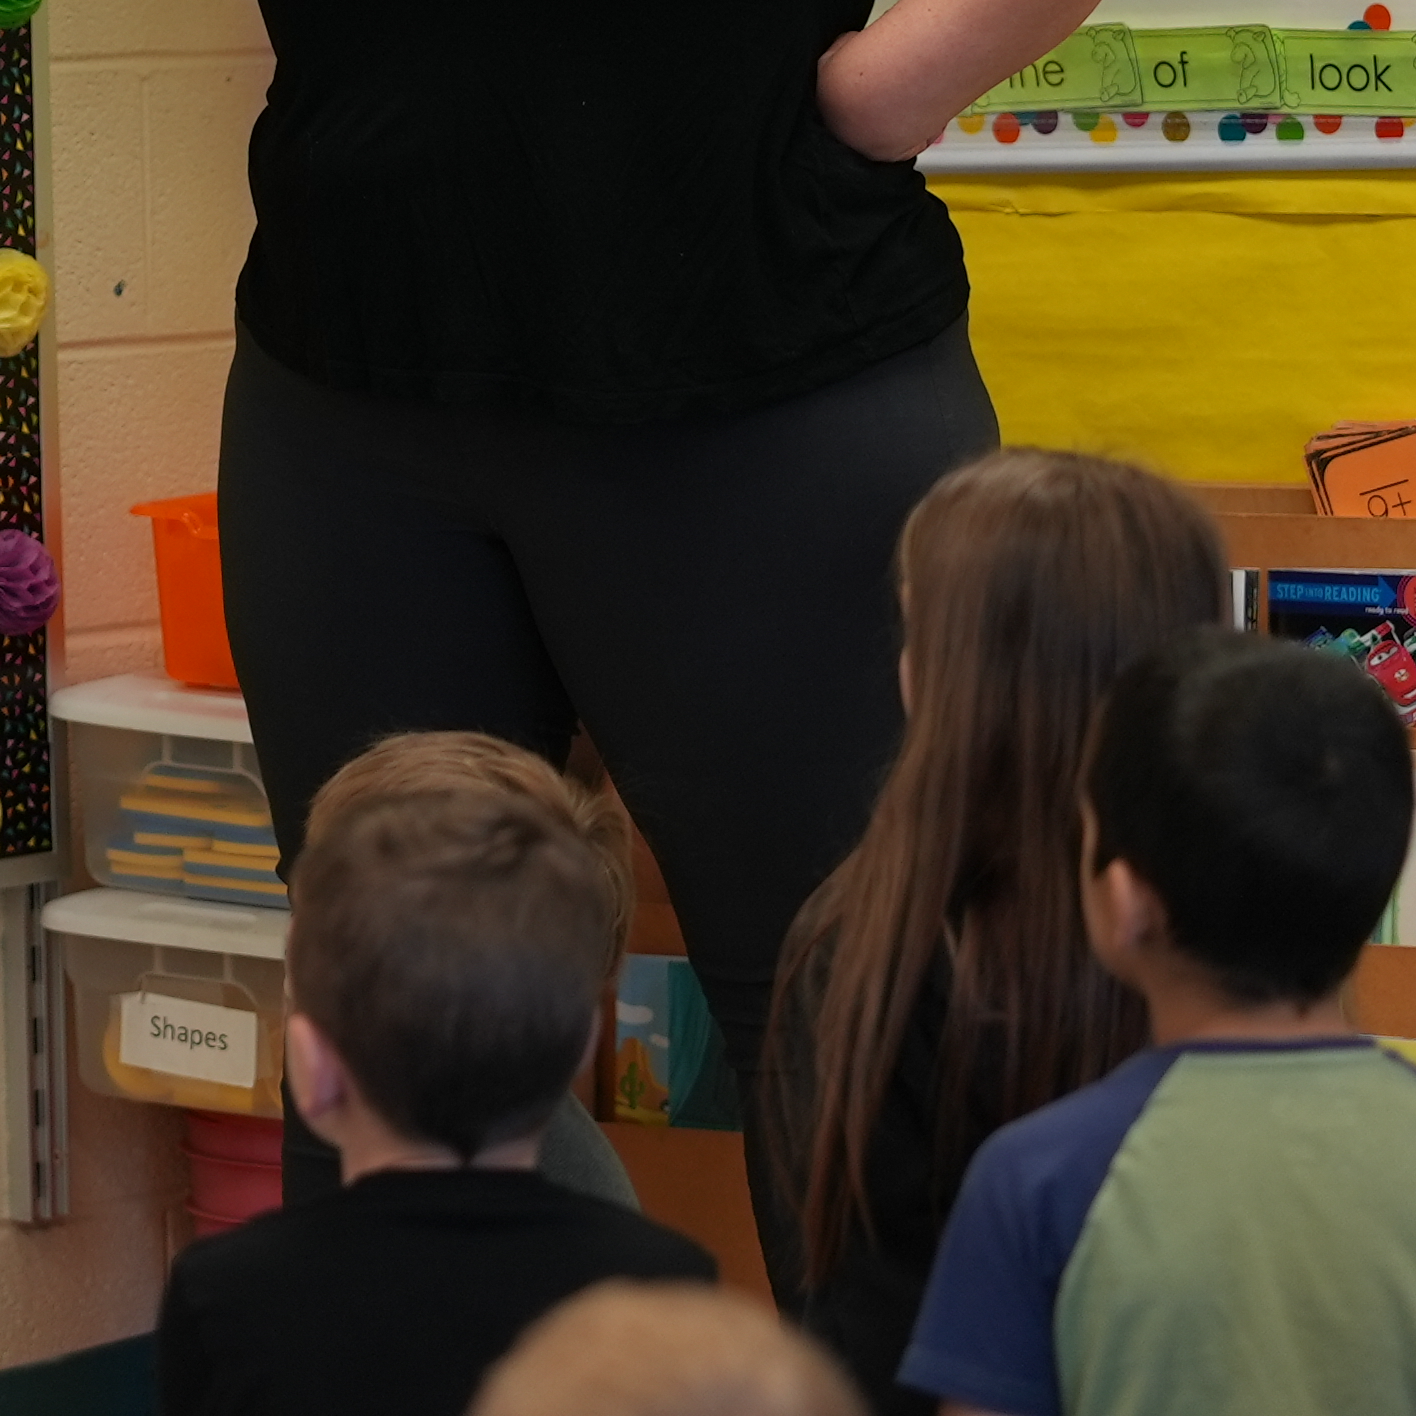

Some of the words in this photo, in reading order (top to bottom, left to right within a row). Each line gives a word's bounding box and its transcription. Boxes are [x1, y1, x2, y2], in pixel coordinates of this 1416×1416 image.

[1153, 50, 1189, 89] of
[1310, 52, 1392, 93] look
[1277, 584, 1304, 599] STEP
[1324, 586, 1379, 602] READING
[150, 1016, 229, 1051] Shapes
